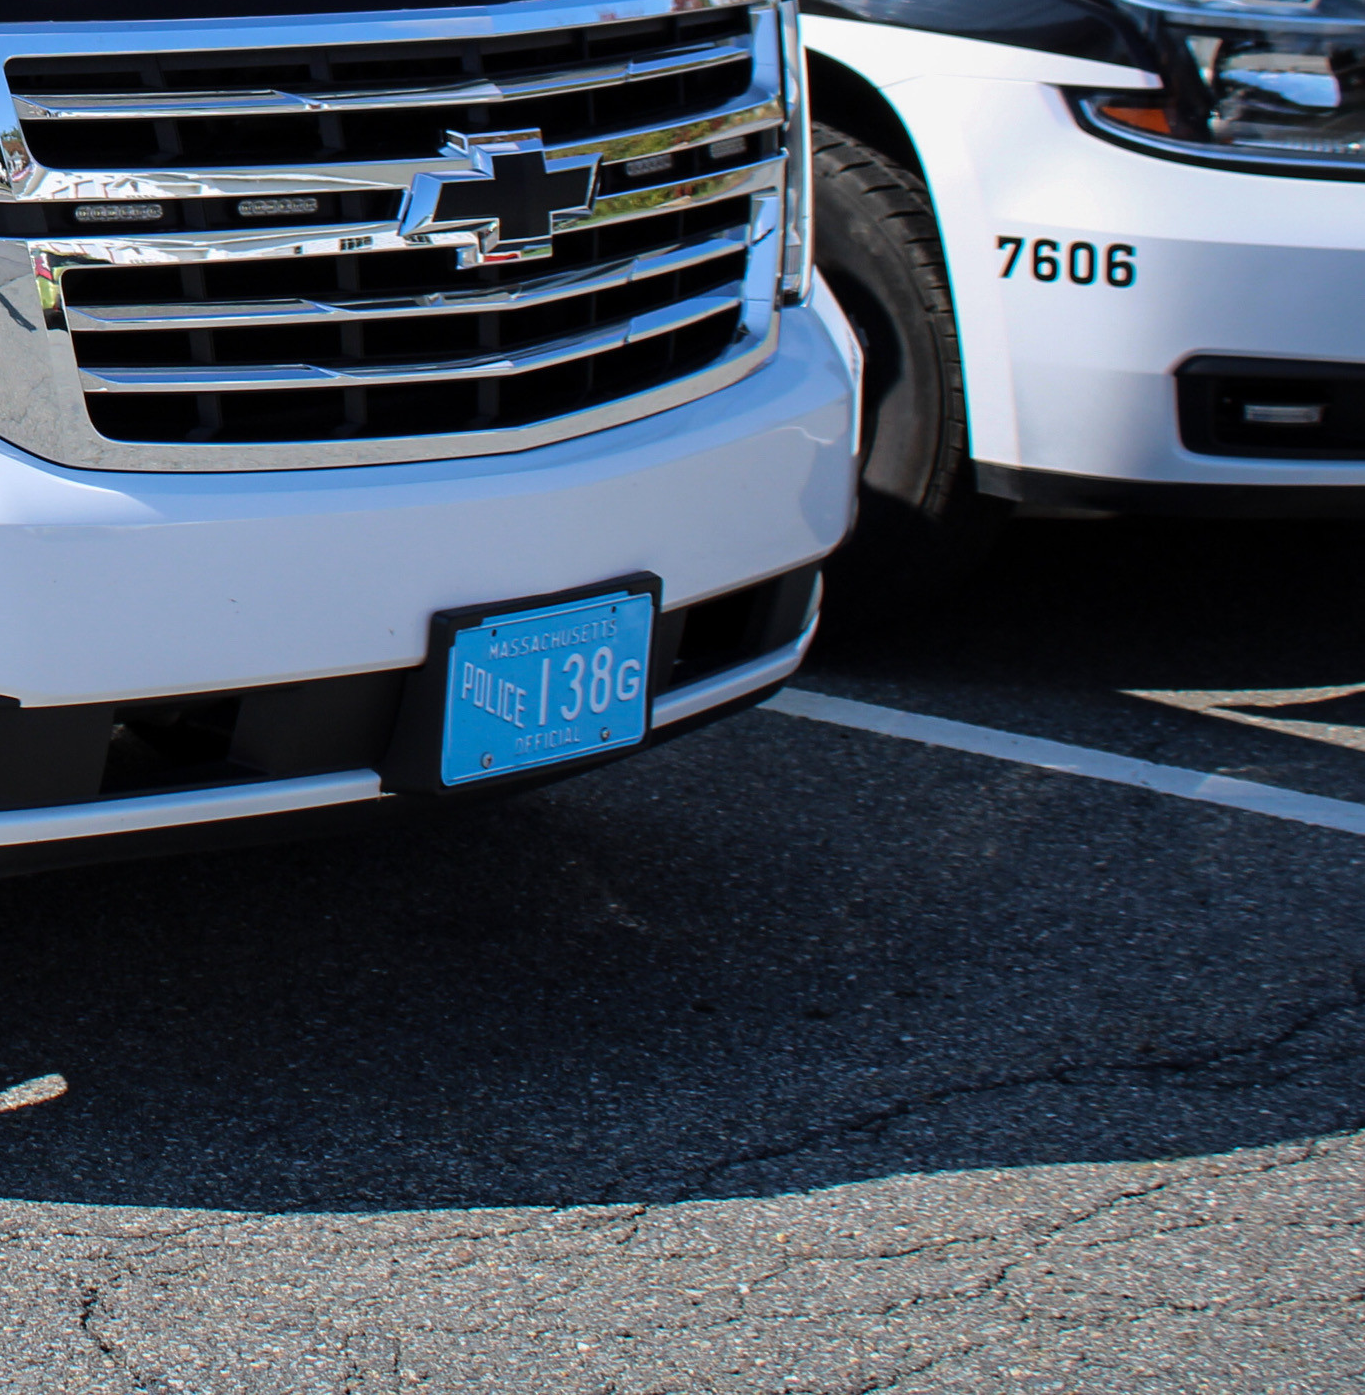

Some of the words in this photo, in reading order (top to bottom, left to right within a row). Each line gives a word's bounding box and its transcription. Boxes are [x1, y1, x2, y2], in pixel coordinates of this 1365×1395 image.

[995, 235, 1137, 288] 7606
[490, 620, 618, 660] MASSACHUSETTS
[462, 661, 527, 728] POLICE
[516, 727, 581, 754] OFFICIAL
